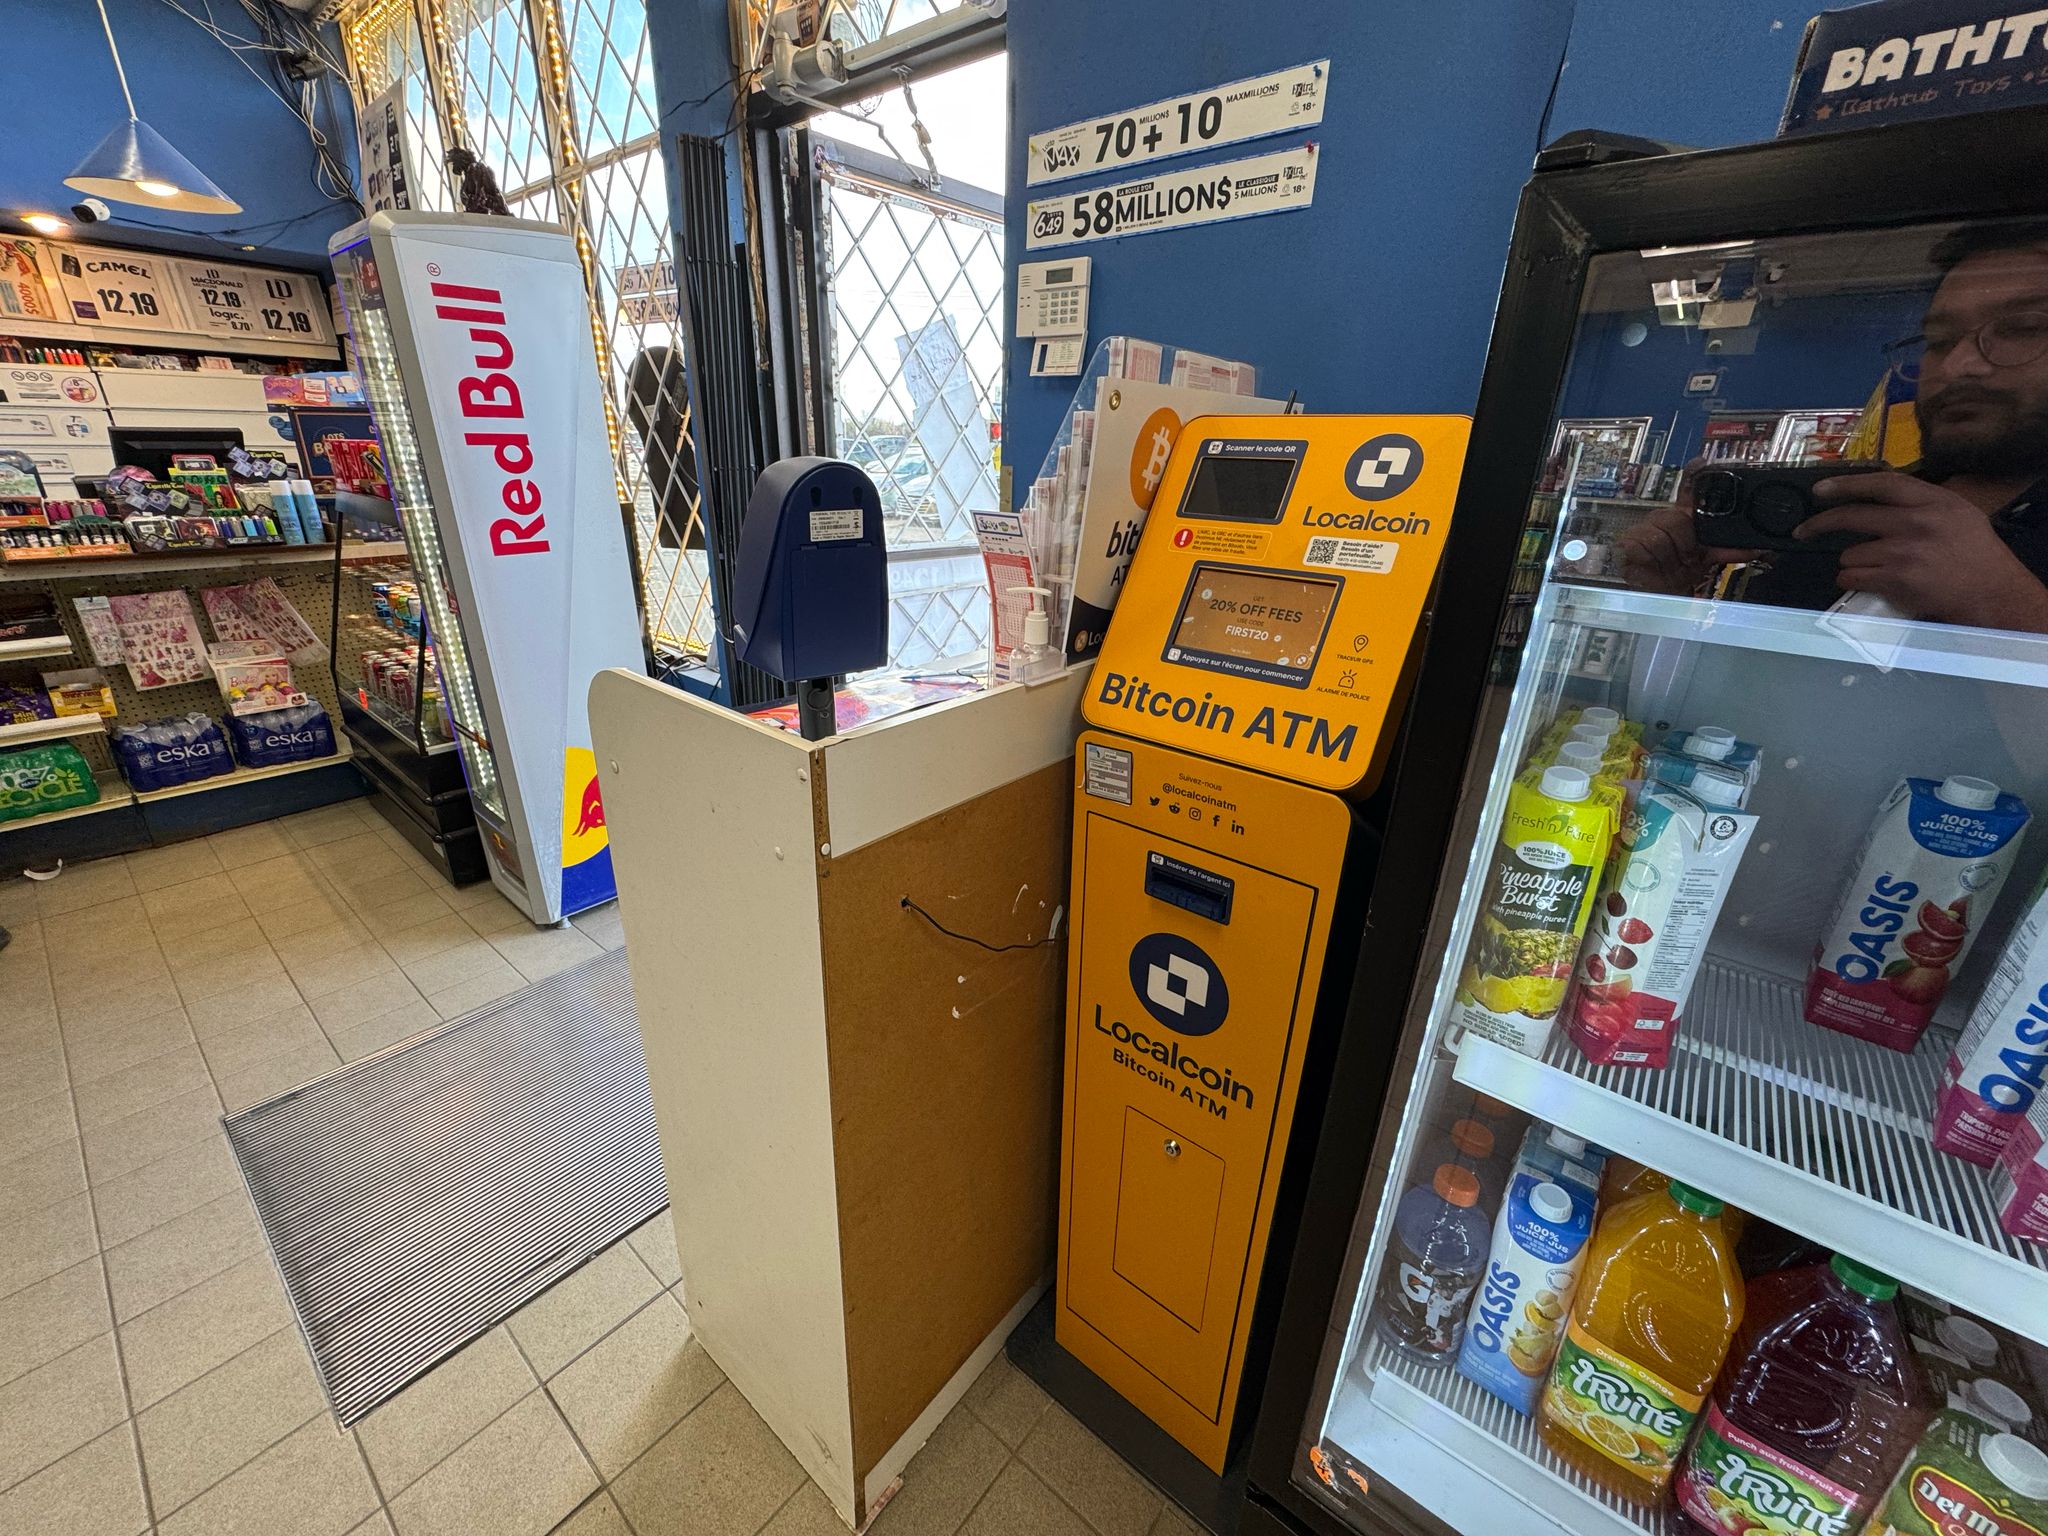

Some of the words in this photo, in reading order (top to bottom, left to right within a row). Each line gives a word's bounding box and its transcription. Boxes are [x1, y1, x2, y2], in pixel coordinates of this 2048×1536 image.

[1822, 9, 2048, 93] BATHT
[1095, 118, 1137, 163] 70
[1177, 96, 1222, 145] 10
[1072, 191, 1114, 238] 58
[1115, 176, 1232, 225] MILLION$
[86, 261, 152, 279] CAMEL
[430, 282, 525, 418] Bull
[1264, 445, 1283, 453] code
[465, 433, 551, 556] Red
[1302, 506, 1430, 535] Localcoin
[1209, 599, 1237, 613] 20%
[1239, 603, 1267, 617] OFF
[1268, 607, 1303, 623] FEES
[1225, 624, 1269, 641] FIRST20
[1181, 653, 1210, 665] Appuyez
[1222, 659, 1244, 671] l'écran
[1245, 665, 1261, 675] pour
[1261, 668, 1303, 682] commencer
[1099, 672, 1235, 733] Bitcoin
[1242, 706, 1358, 763] ATM
[157, 743, 210, 763] eska
[265, 730, 314, 747] eska
[1179, 773, 1222, 791] Suivez-nous
[1162, 783, 1237, 812] @localcoinatm
[1940, 813, 1986, 831] 100%
[1166, 860, 1188, 872] Insérer
[1189, 867, 1197, 875] de
[1498, 863, 1582, 896] Pineapple
[1500, 885, 1561, 911] Burst
[1505, 907, 1542, 920] pineapple
[1835, 875, 1920, 984] OASIS
[1095, 1003, 1254, 1109] Localcoin
[1113, 1047, 1175, 1093] Bitcoin
[1180, 1086, 1227, 1120] ATM
[1528, 1221, 1559, 1242] 100%
[1472, 1262, 1521, 1354] OASIS
[1596, 1347, 1632, 1370] Orange
[1638, 1370, 1675, 1397] Orange
[1728, 1432, 1758, 1451] Punch
[1759, 1449, 1777, 1462] aux
[1918, 1477, 1965, 1520] Del
